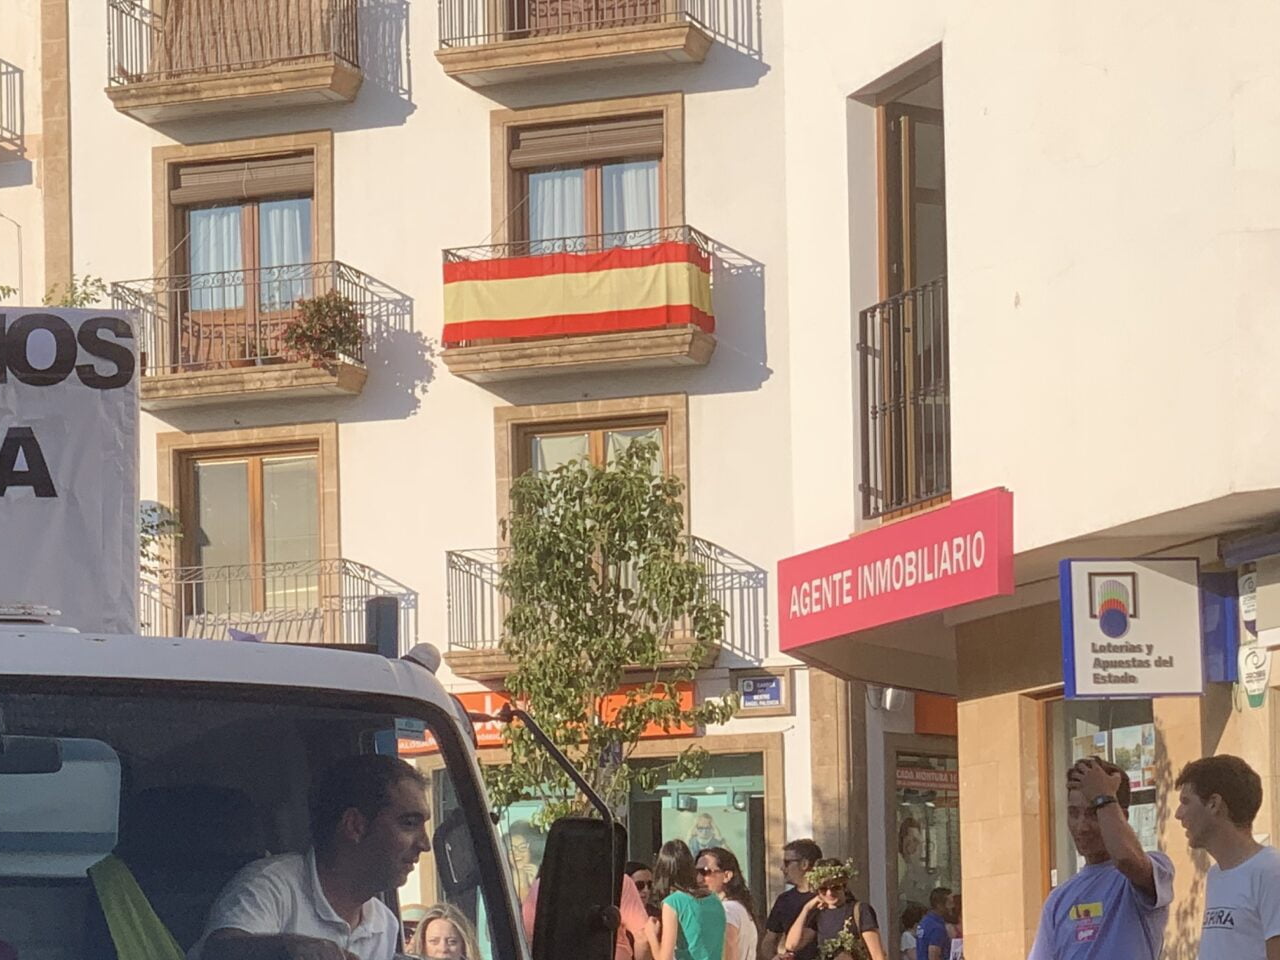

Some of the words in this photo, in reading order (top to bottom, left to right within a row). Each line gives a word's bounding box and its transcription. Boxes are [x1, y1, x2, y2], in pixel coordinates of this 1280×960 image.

[789, 569, 853, 619] AGENTE
[857, 530, 986, 600] INMOBILIARIO
[1145, 644, 1154, 656] y
[1092, 657, 1151, 672] Apuestas
[1154, 655, 1174, 668] del
[1092, 672, 1138, 684] Estado
[916, 771, 948, 782] MONTURA
